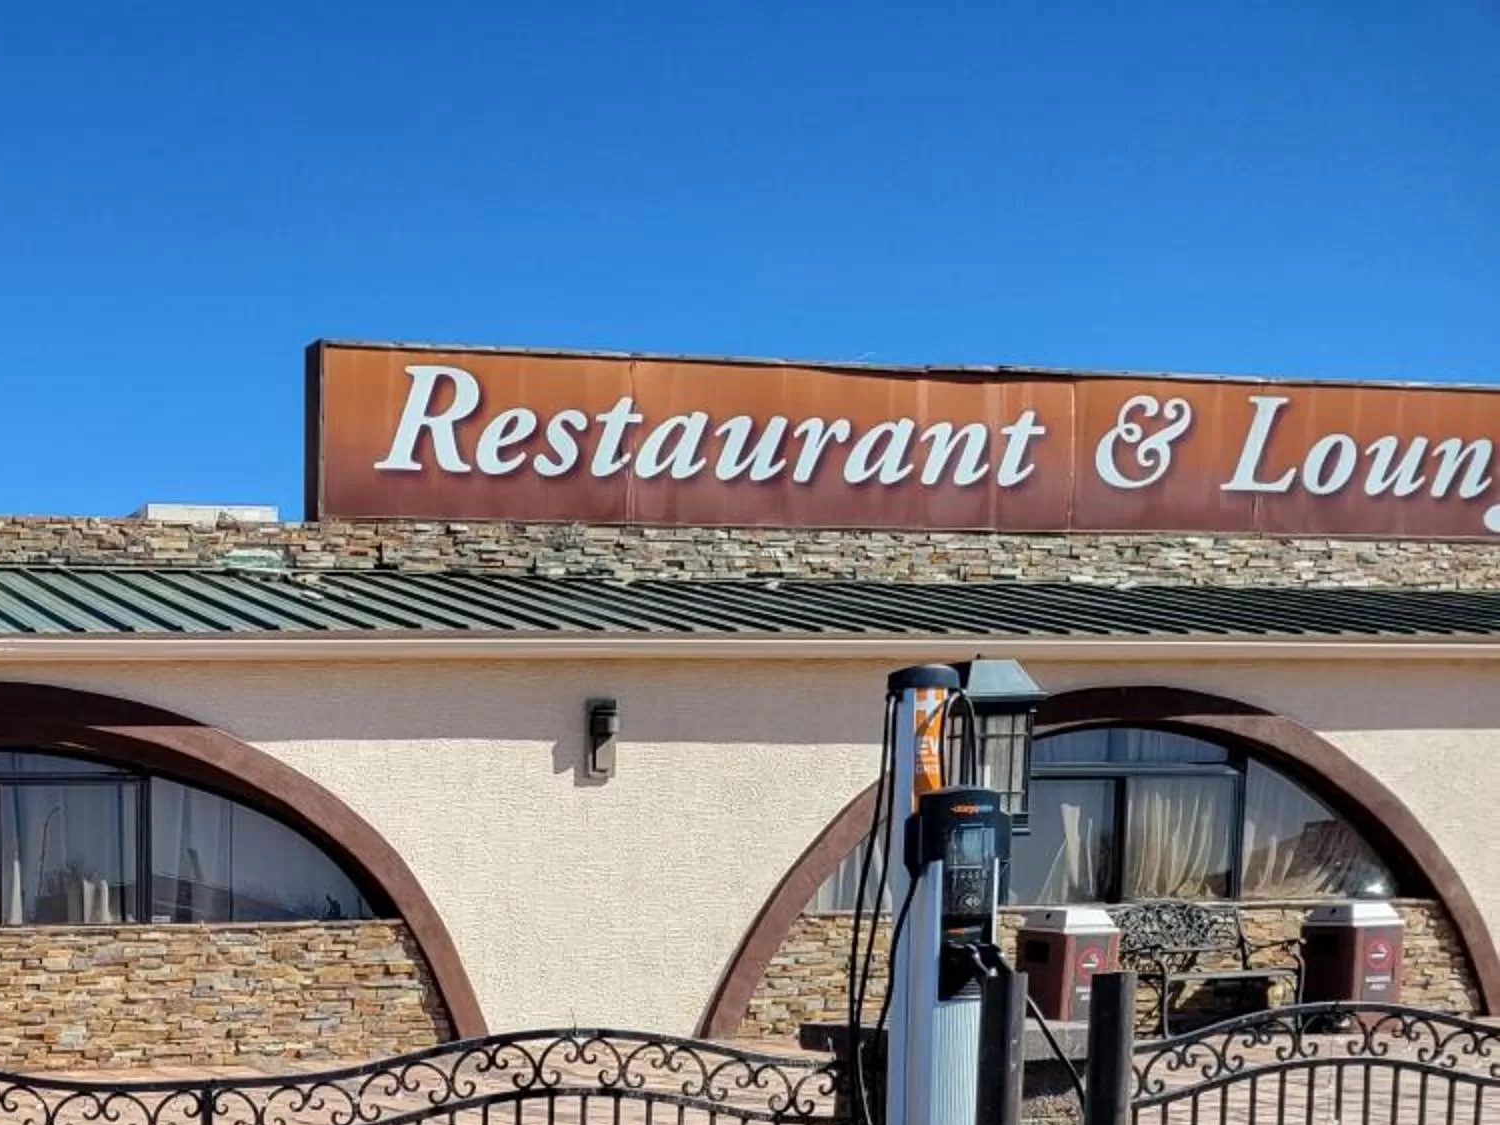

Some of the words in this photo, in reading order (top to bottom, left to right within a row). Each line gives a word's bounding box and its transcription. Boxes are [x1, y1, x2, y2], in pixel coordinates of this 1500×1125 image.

[372, 364, 1047, 487] Restaurant
[1095, 395, 1193, 489] &
[1219, 395, 1500, 532] Loun
